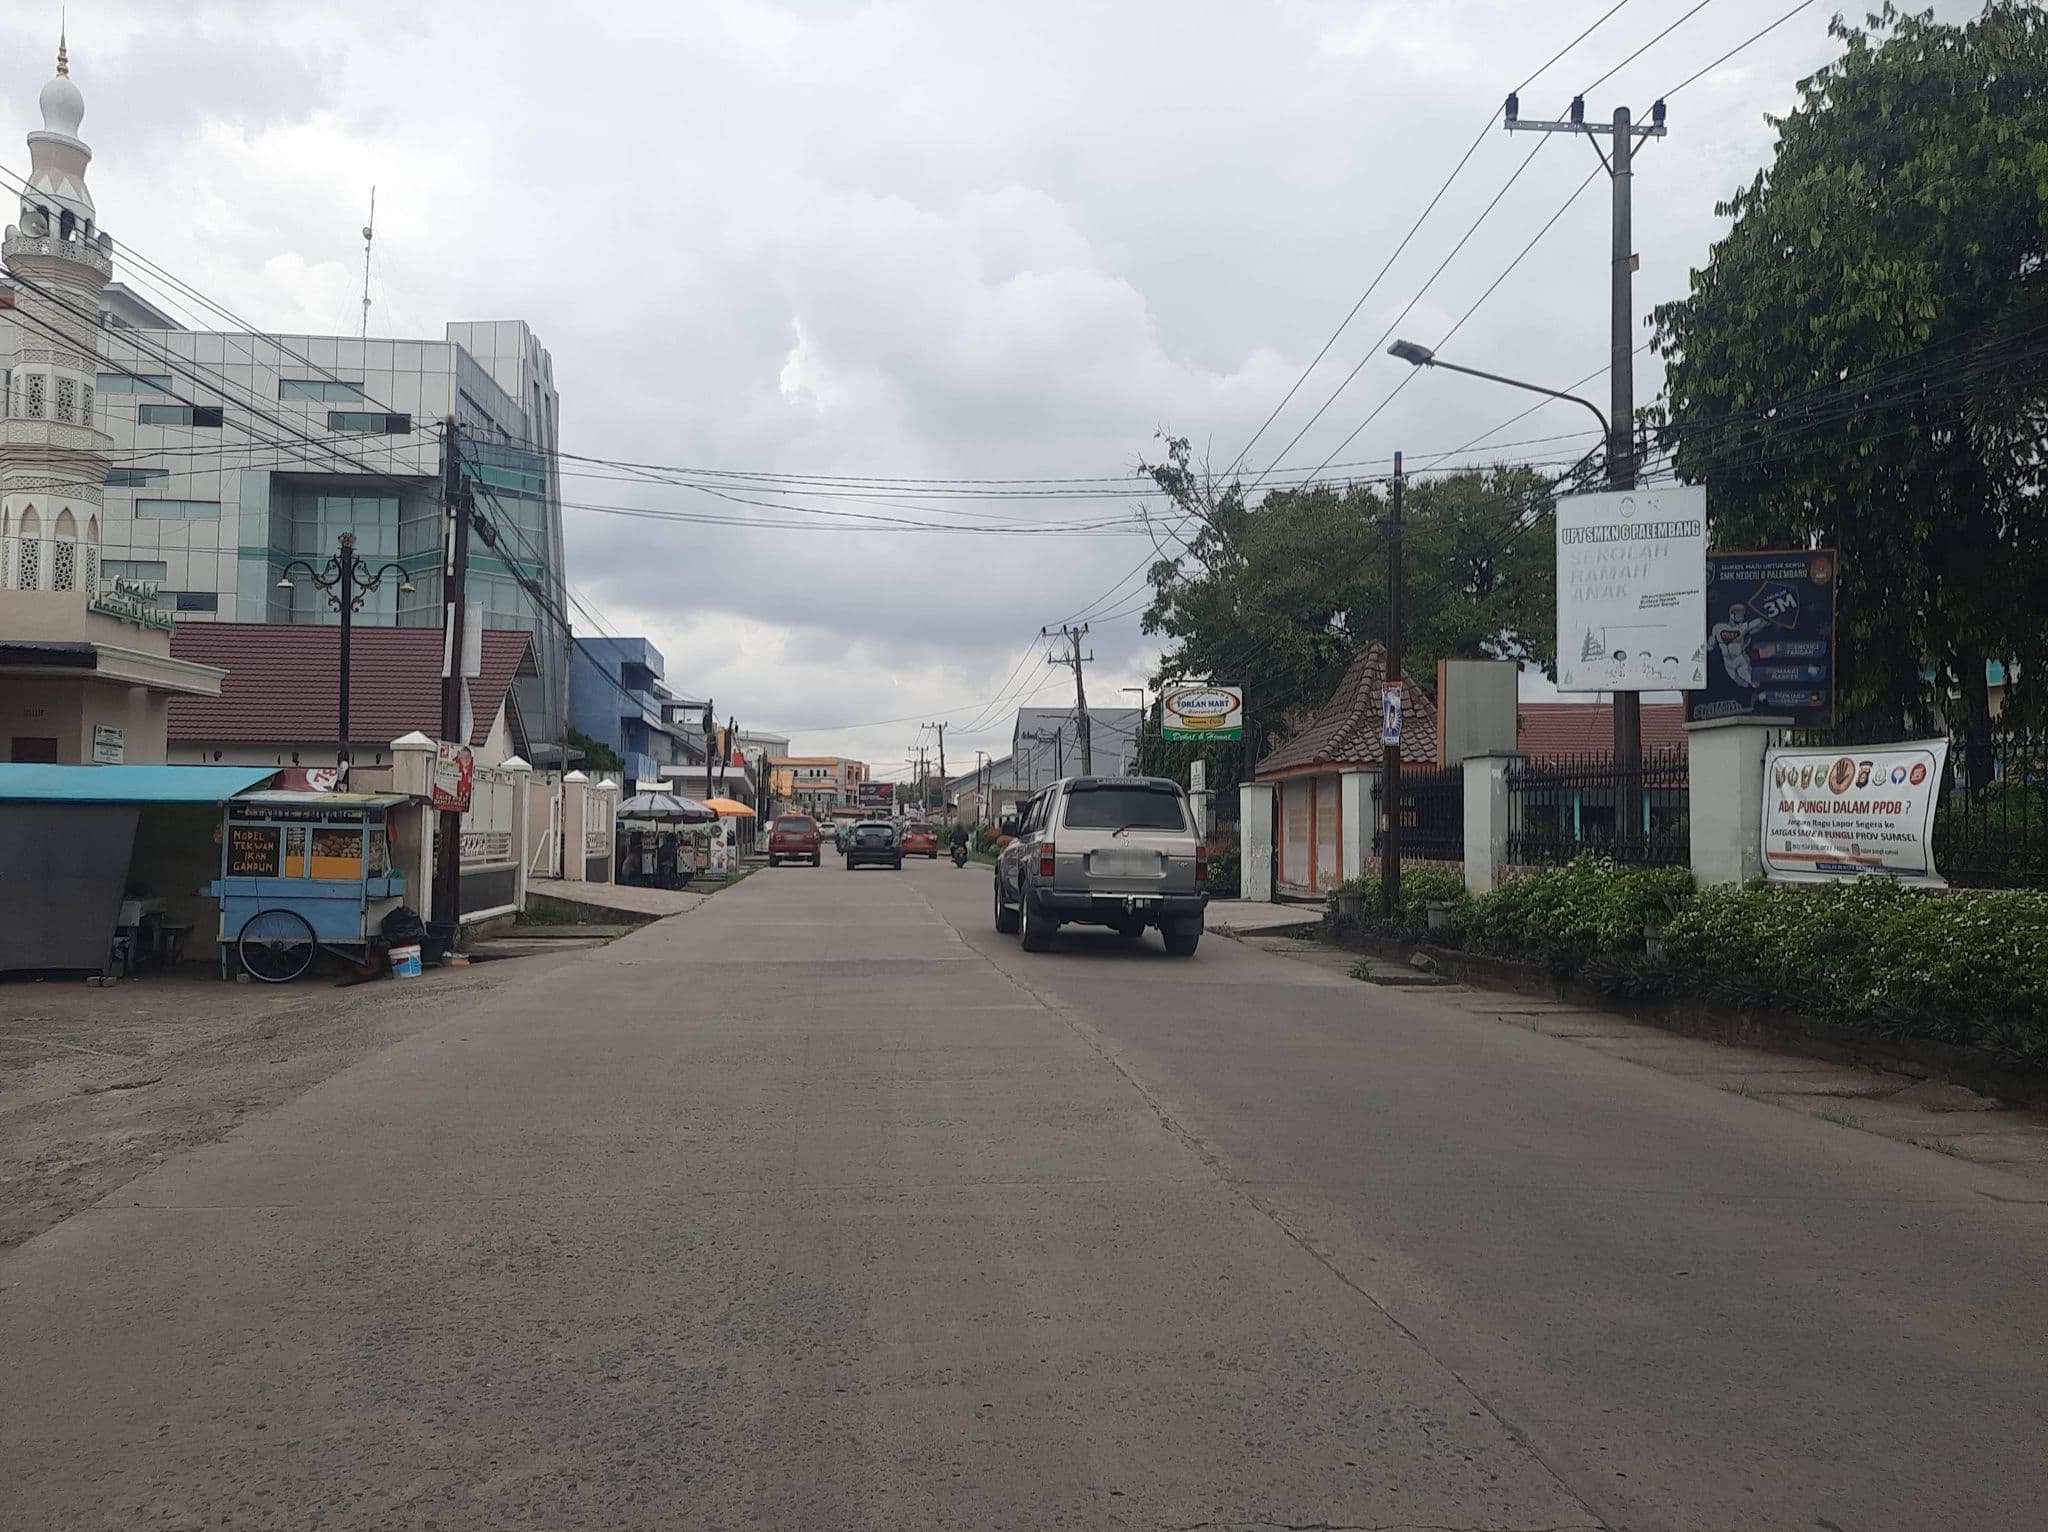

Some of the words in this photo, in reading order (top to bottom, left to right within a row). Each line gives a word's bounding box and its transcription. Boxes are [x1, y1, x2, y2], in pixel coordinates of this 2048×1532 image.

[1562, 528, 1585, 544] UPT
[1585, 525, 1620, 543] SMKN
[1621, 524, 1630, 541] 6
[1631, 520, 1700, 540] PALEMBANG
[1572, 543, 1669, 565] SEKOLAH
[1571, 563, 1648, 583] RAMAH
[1720, 571, 1735, 581] SMK
[1735, 570, 1759, 581] NEGERI
[1766, 568, 1808, 579] PALEMBANG
[1572, 584, 1630, 601] ANAK
[1763, 593, 1796, 618] 3M
[1778, 800, 1794, 813] ADA
[1797, 800, 1831, 814] PUNGLI
[1833, 801, 1869, 814] DALAM
[1872, 801, 1902, 815] PPDB
[1905, 801, 1912, 815] ?
[1812, 820, 1831, 828] Ragu
[1832, 820, 1854, 829] Lapor
[1855, 820, 1883, 829] Segera
[1884, 820, 1895, 828] ke
[1824, 831, 1854, 840] PUNGLI
[1855, 832, 1878, 841] PROV
[1880, 833, 1918, 842] SUMSEL
[233, 841, 273, 851] TEKWAN
[245, 851, 267, 861] IKAN
